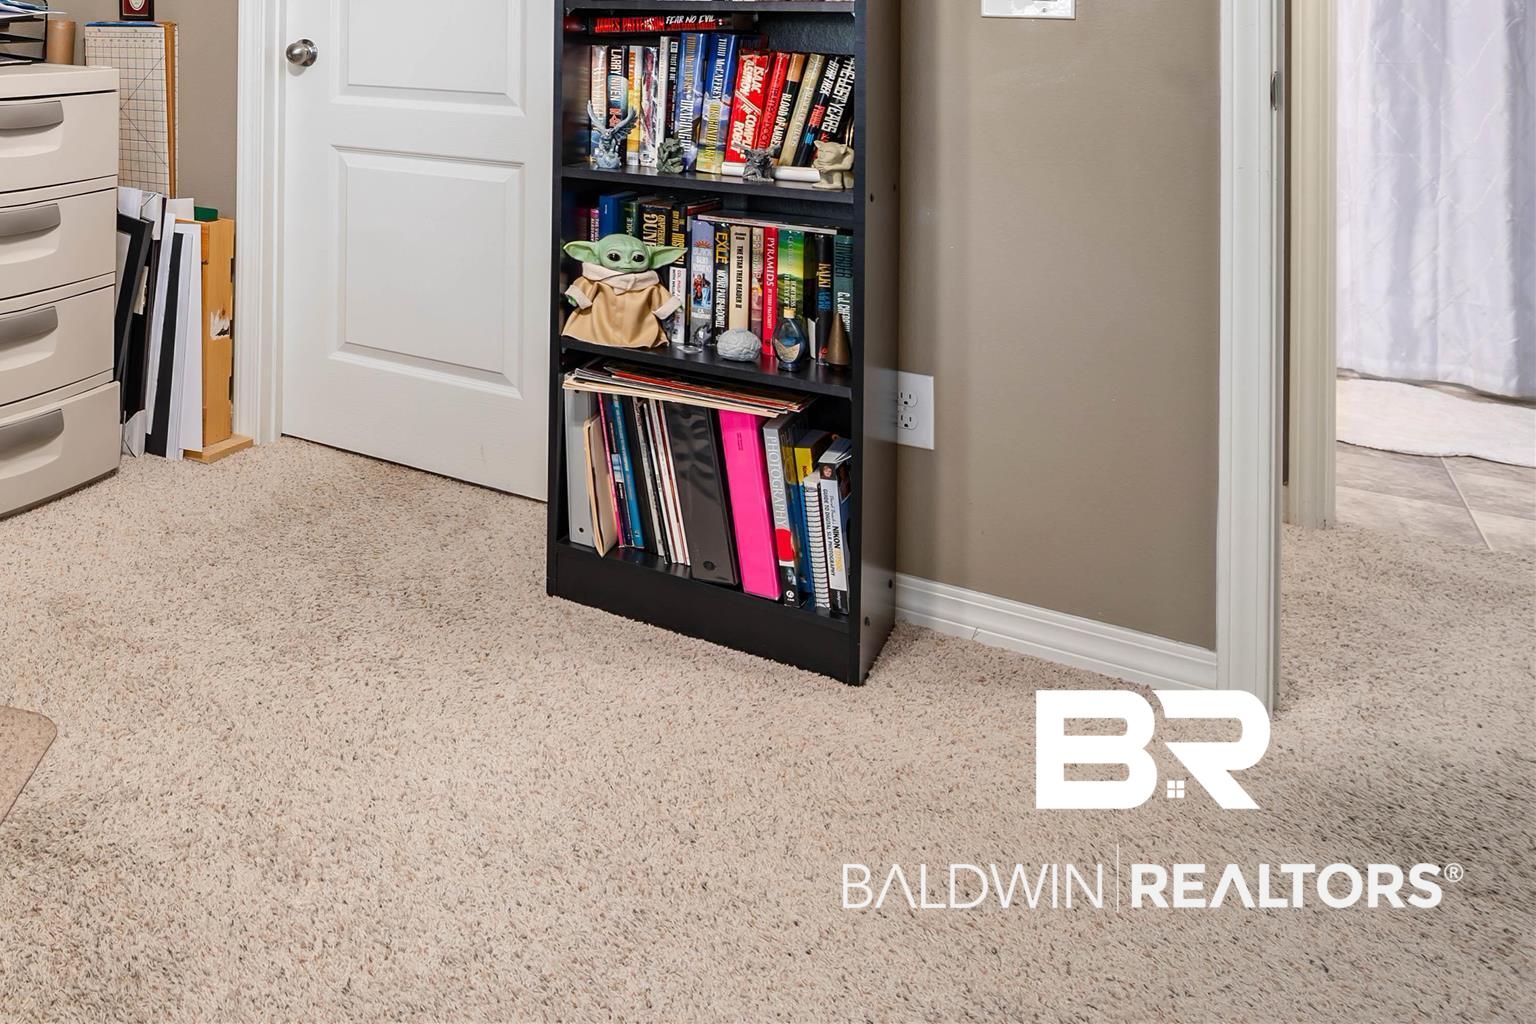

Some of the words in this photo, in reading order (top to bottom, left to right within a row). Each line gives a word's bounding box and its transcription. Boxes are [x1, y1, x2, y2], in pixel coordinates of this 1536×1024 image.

[665, 15, 683, 24] FEAR
[685, 15, 696, 24] NO
[698, 14, 715, 24] EVIL
[718, 38, 728, 57] TODD
[610, 48, 622, 75] LARRY
[825, 59, 840, 80] STAR
[839, 57, 856, 80] THE
[610, 77, 622, 101] NIVEN
[711, 57, 726, 100] McCAFFREY
[738, 59, 755, 97] ASIMOV
[750, 66, 765, 93] ISAAC
[819, 78, 835, 97] TREK
[832, 77, 854, 104] LOST
[777, 93, 793, 117] BLOOD
[775, 116, 788, 127] OF
[821, 102, 846, 134] YEARS
[704, 103, 721, 163] DRAGONHEART
[770, 125, 786, 148] AMBE
[656, 214, 666, 247] CHAPTERHOU
[715, 231, 729, 264] EXILE
[736, 245, 744, 256] THE
[736, 256, 744, 269] STAR
[766, 237, 775, 287] PYRAMIDS
[835, 242, 853, 279] INVADER
[736, 269, 744, 282] TREK
[817, 263, 832, 288] KALKI
[735, 283, 743, 303] READER
[765, 435, 788, 528] PHOTOGRAPHY
[822, 488, 831, 504] GUIDE
[827, 541, 836, 577] PHOTOGRAPHY
[833, 525, 843, 549] NIKON
